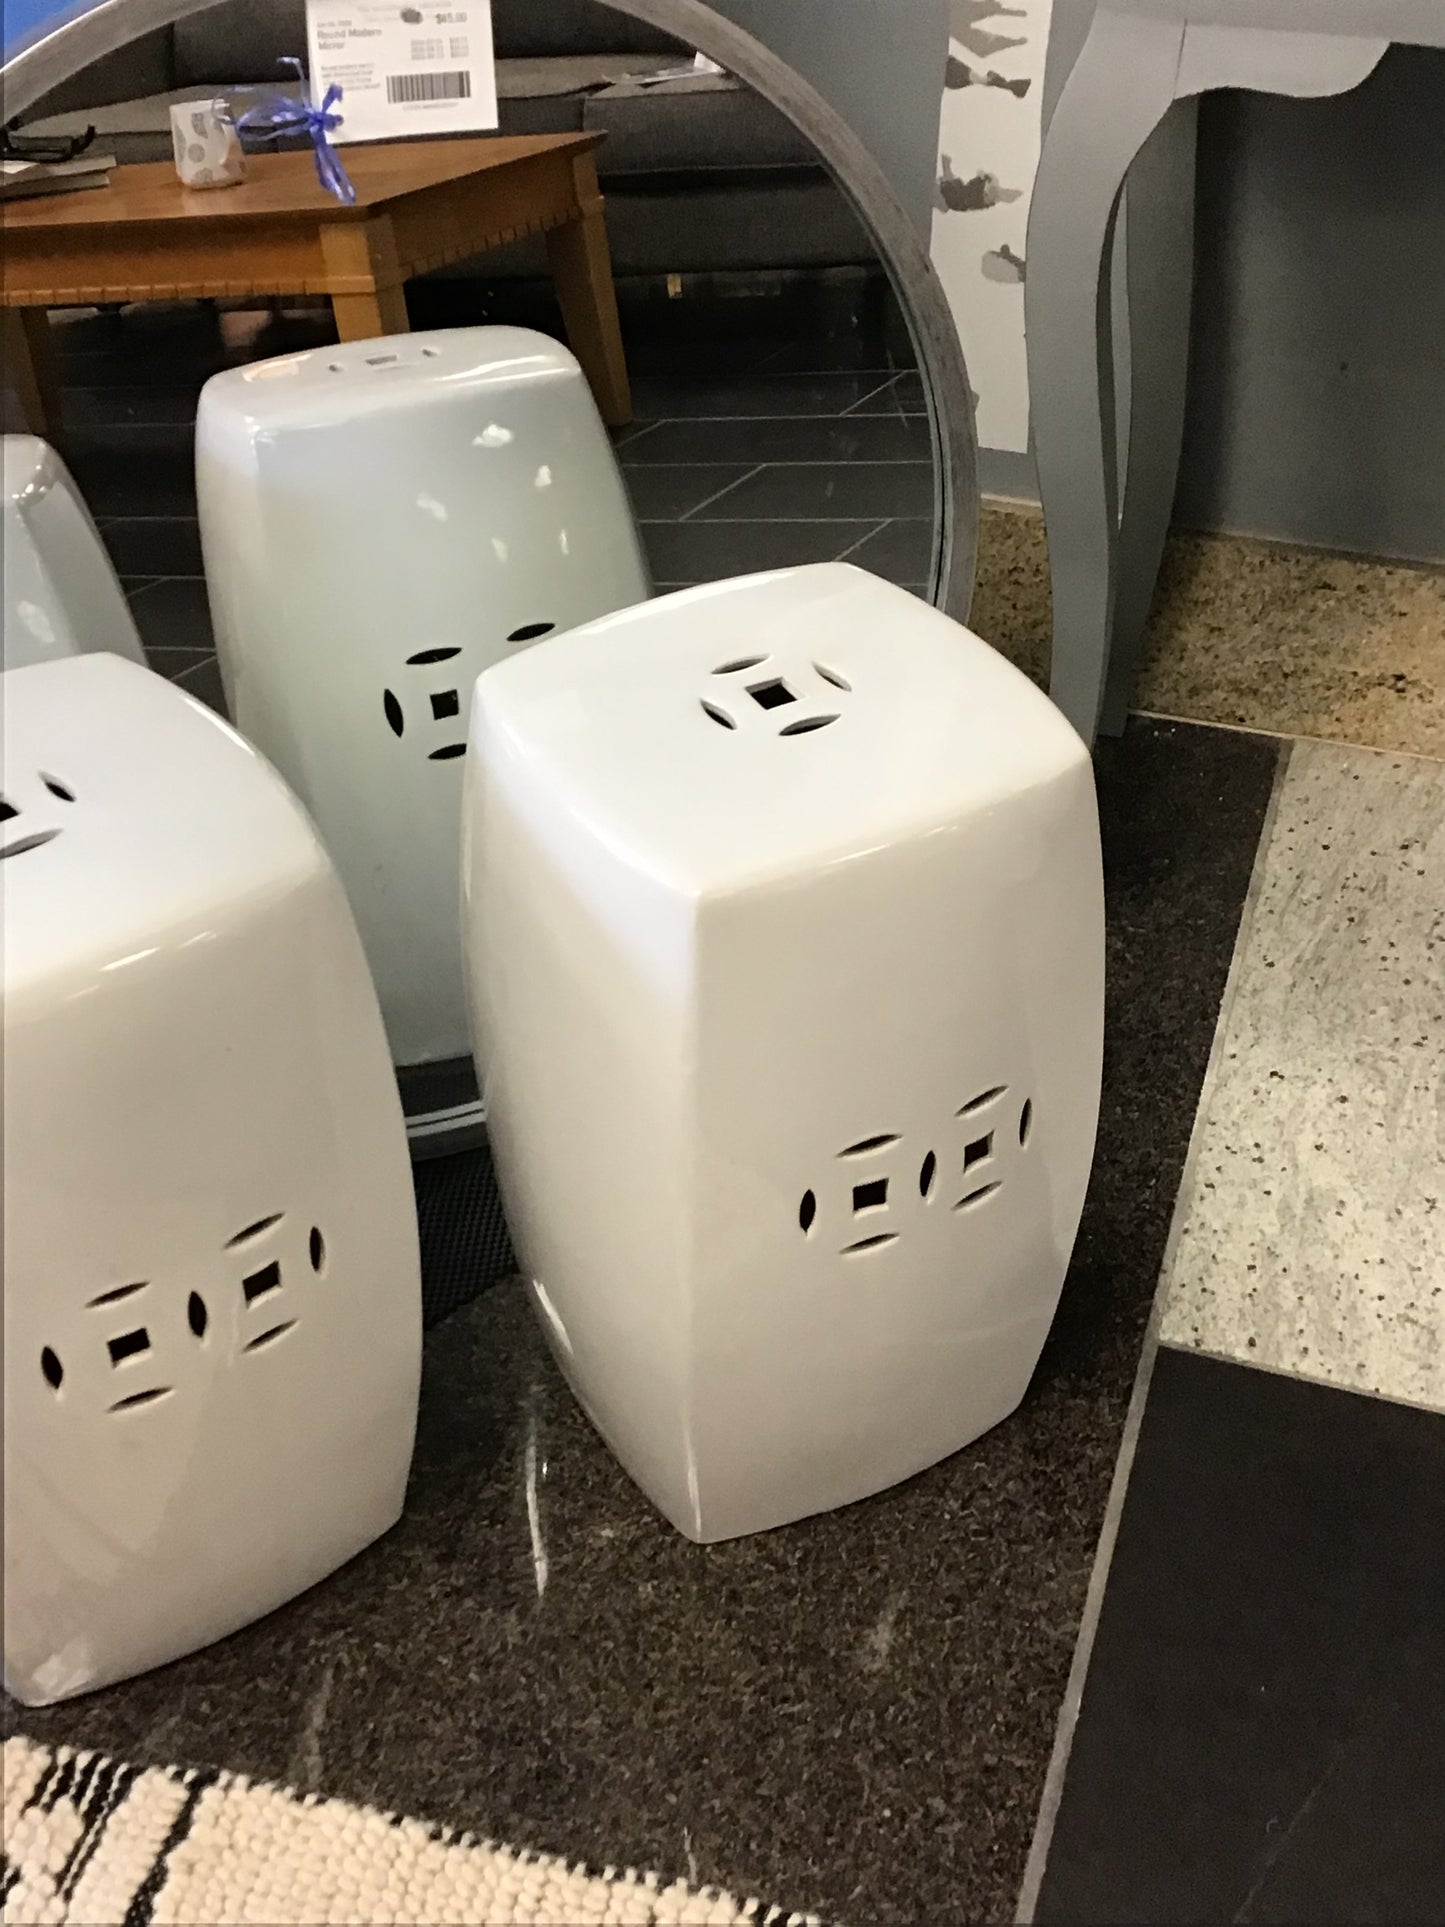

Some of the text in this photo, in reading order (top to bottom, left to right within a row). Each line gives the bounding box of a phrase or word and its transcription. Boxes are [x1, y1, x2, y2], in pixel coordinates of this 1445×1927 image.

[317, 28, 382, 39] Round Modern
[318, 41, 345, 50] Mirror
